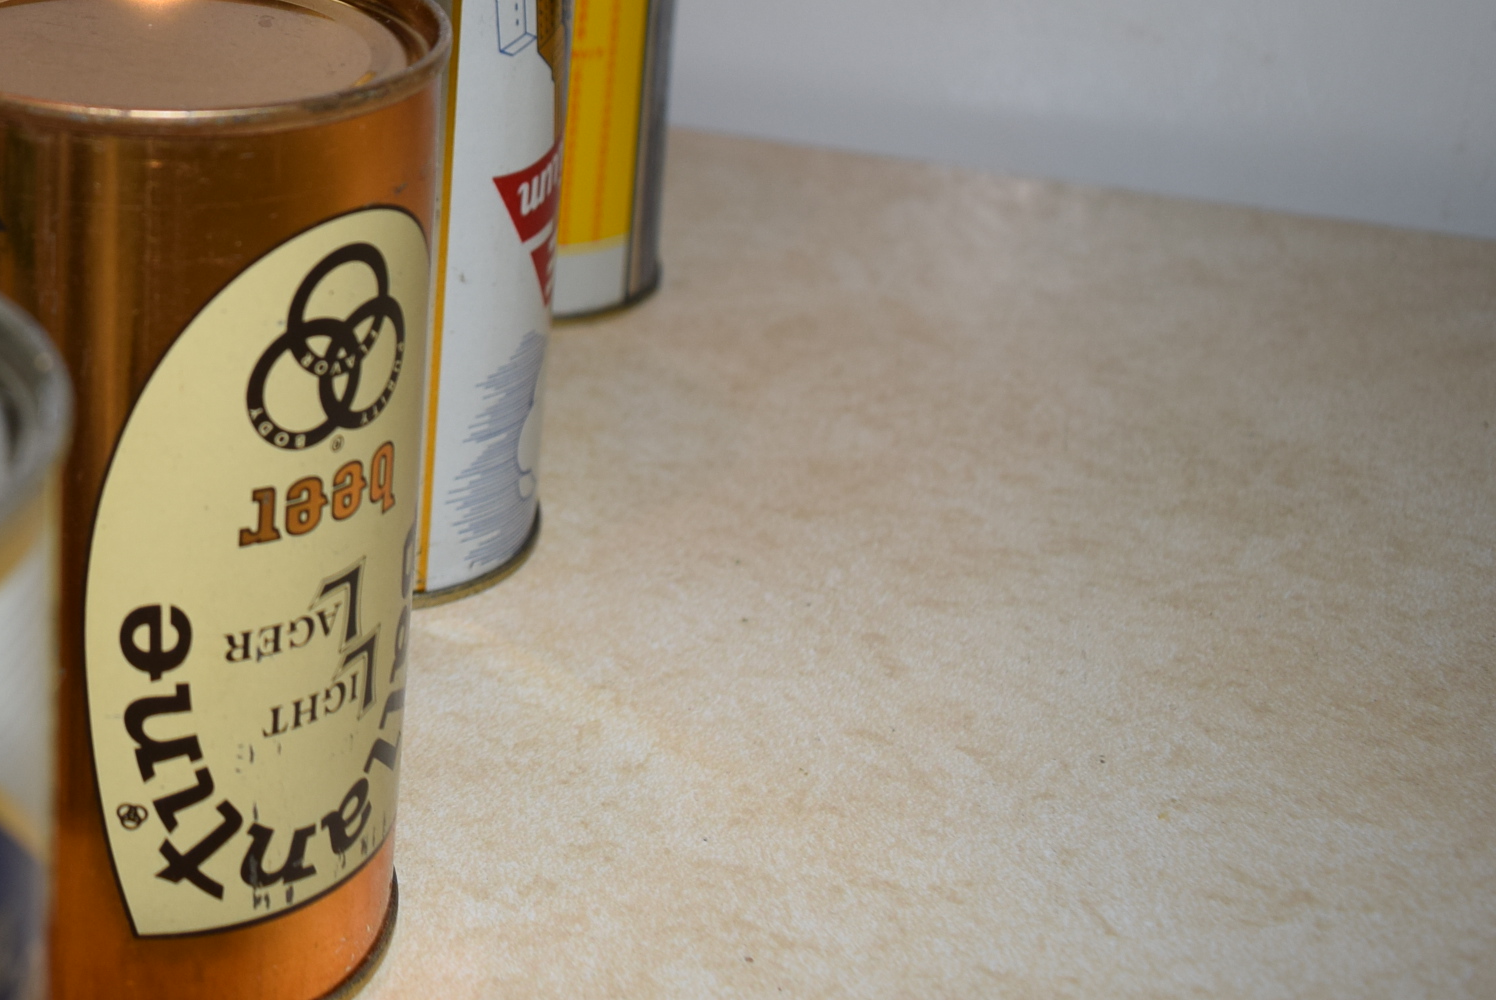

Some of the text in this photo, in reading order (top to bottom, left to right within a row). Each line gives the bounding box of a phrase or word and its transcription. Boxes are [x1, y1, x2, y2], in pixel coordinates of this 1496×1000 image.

[299, 328, 378, 376] FLAVOR
[359, 340, 405, 426] PURITY
[249, 406, 307, 449] BODY
[238, 440, 395, 548] beer
[224, 556, 367, 663] LAGER
[262, 622, 382, 738] LIGHT
